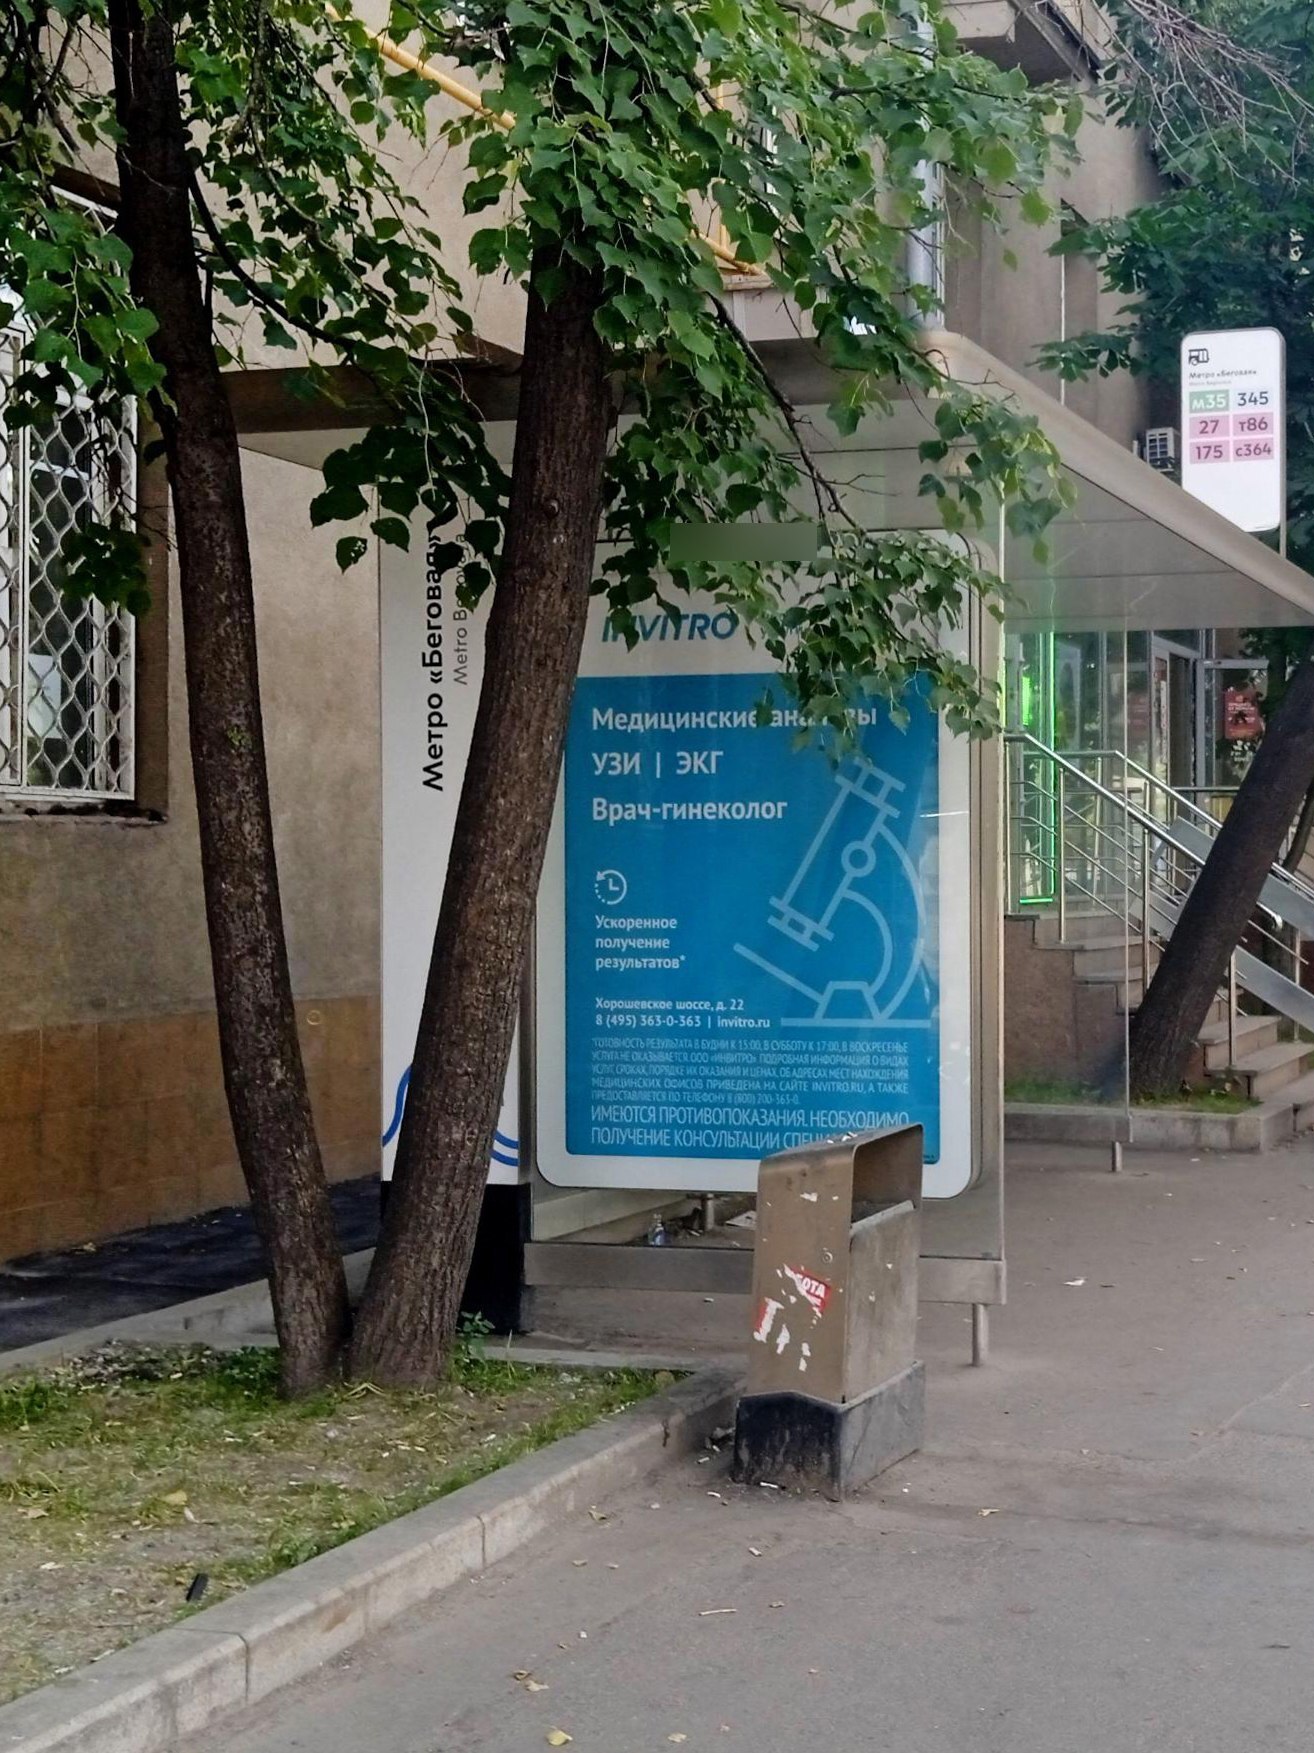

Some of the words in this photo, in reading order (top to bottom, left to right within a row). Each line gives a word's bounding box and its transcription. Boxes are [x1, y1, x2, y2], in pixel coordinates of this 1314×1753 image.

[1192, 394, 1226, 410] м35
[1238, 391, 1269, 406] 345
[1199, 420, 1219, 434] 27
[1238, 416, 1268, 432] т86
[1196, 445, 1223, 460] 175
[453, 629, 468, 685] Metro
[592, 708, 756, 732] Медицинские
[422, 692, 448, 791] Метро
[592, 752, 640, 776] УЗИ
[676, 751, 724, 776] ЭКГ
[592, 797, 788, 826] Врач-гинеколог
[595, 915, 678, 932] Ускоренное
[595, 937, 670, 952] получение
[595, 997, 673, 1011] Хорошевское
[676, 1001, 714, 1012] шоссе,
[716, 1001, 727, 1012] д.
[730, 998, 744, 1011] 22
[595, 1014, 603, 1026] 8
[606, 1014, 637, 1029] (495)
[640, 1014, 701, 1028] 363-0-363
[717, 1016, 771, 1029] invitro.ru
[850, 1042, 909, 1053] ВОСКРЕСЕНЬЕ
[690, 1052, 708, 1063] ООО
[592, 1077, 662, 1090] МЕДИЦИНСКИХ
[664, 1078, 704, 1090] ОФИСОВ
[706, 1079, 761, 1092] ПРИВЕДЕНА
[764, 1081, 777, 1090] НА
[780, 1080, 809, 1092] САЙТЕ
[868, 1083, 875, 1093] А
[877, 1083, 909, 1094] ТАКЖЕ
[591, 1105, 656, 1124] ИМЕЮТСЯ
[659, 1107, 808, 1128] ПРОТИВОПОКАЗАНИЯ.
[810, 1110, 910, 1130] НЕОБХОДИМО
[591, 1127, 670, 1147] ПОЛУЧЕНИЕ
[674, 1129, 780, 1150] КОНСУЛЬТАЦИИ
